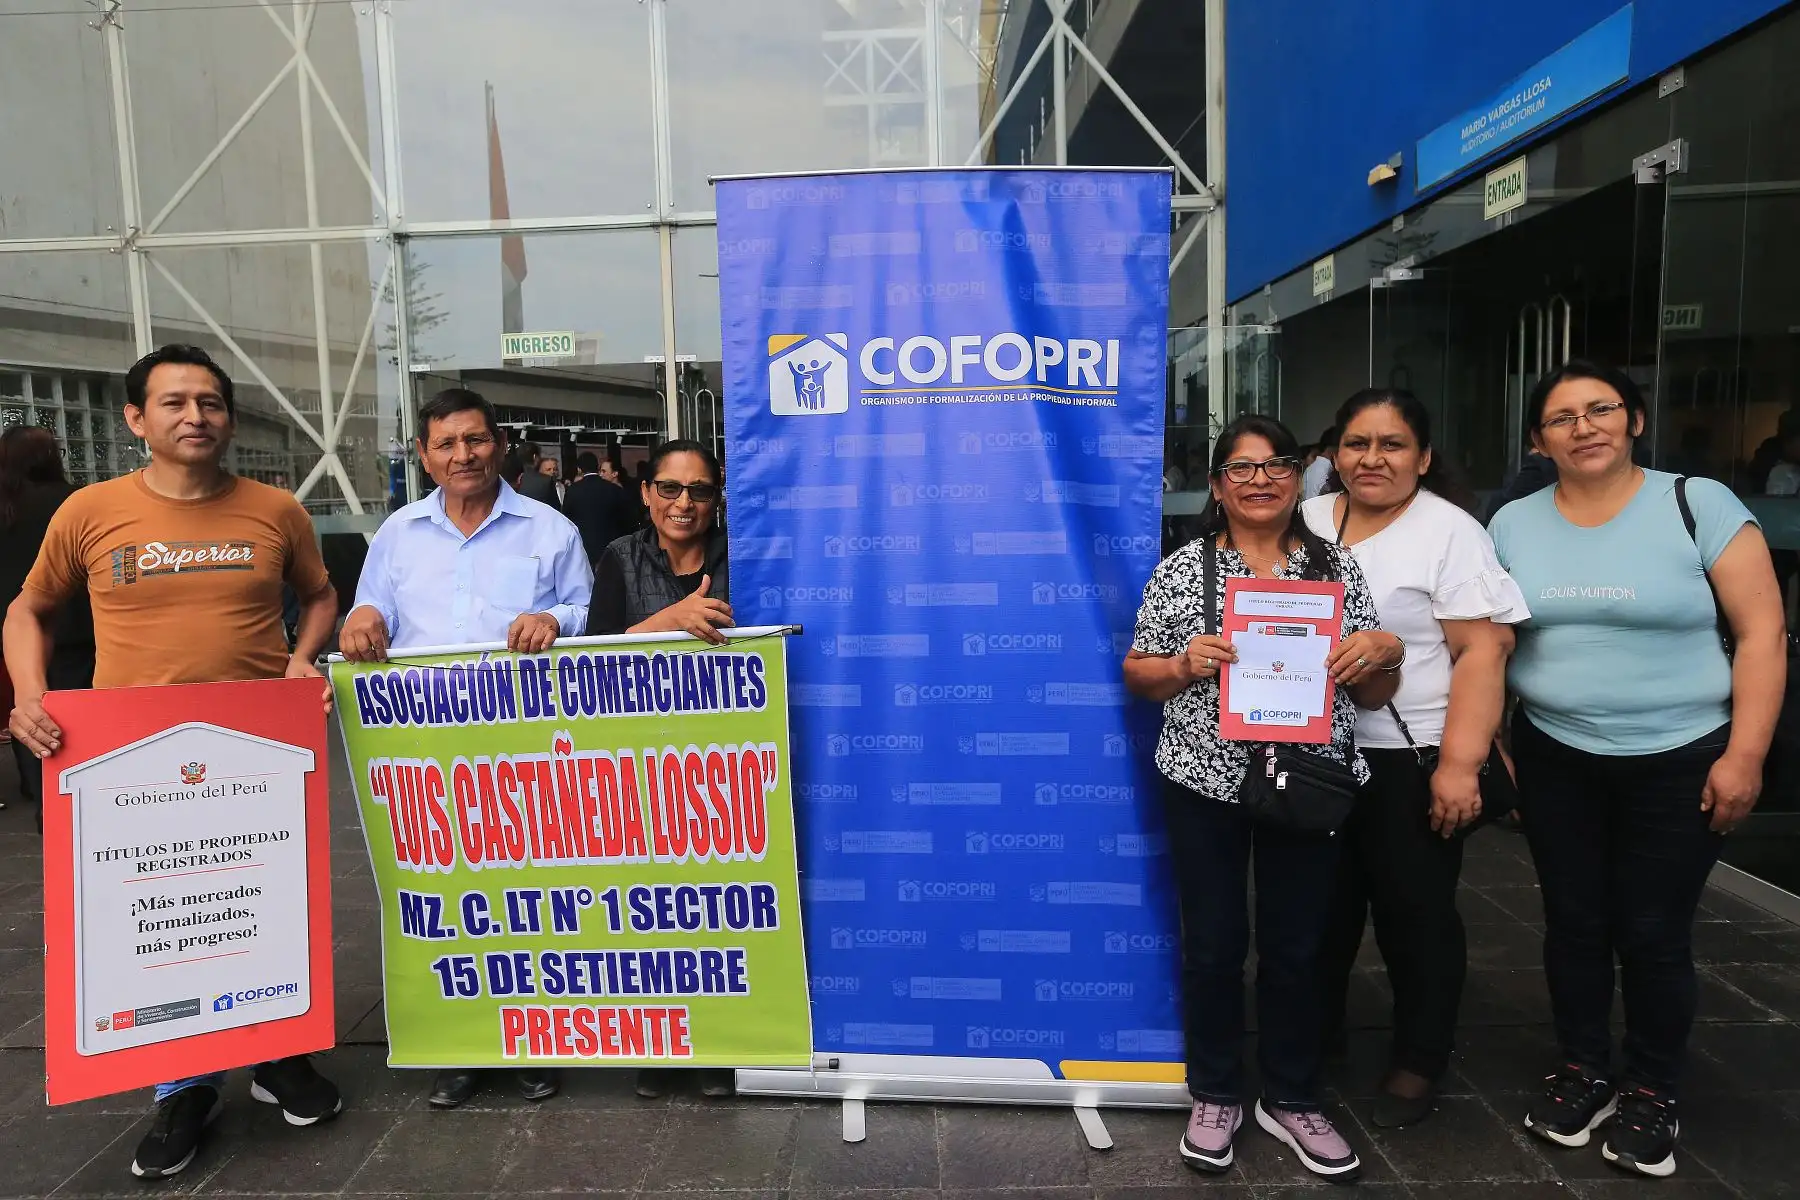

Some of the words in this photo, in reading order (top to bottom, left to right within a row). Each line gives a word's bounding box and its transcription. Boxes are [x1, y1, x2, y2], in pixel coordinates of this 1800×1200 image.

[1461, 115, 1487, 139] MARIO
[1488, 95, 1521, 121] VARGAS
[1523, 75, 1552, 102] LLOSA
[1461, 126, 1495, 154] AUDITORIO
[1500, 97, 1546, 131] AUDITORIUM
[1049, 181, 1124, 198] COFOPRI
[1487, 170, 1522, 206] ENTRADA
[718, 238, 777, 254] OFOPRI
[980, 230, 1050, 248] COFOPRI
[912, 281, 985, 298] COFOPRI
[505, 335, 571, 354] INGRESO
[859, 332, 1121, 388] COFOPRI
[860, 396, 915, 406] ORGANISMO
[916, 396, 928, 405] DE
[929, 392, 1002, 405] FORMALIZACIÓN
[1004, 392, 1016, 402] DE
[1017, 392, 1029, 401] LA
[1030, 392, 1072, 405] PROPIEDAD
[1073, 397, 1118, 408] INFORMAL
[725, 438, 785, 454] OFOPRI
[985, 432, 1058, 447] COFOPRI
[915, 484, 989, 499] COFOPRI
[848, 535, 920, 551] COFOPRI
[1111, 535, 1160, 551] COFO
[137, 541, 254, 573] Superior
[784, 586, 854, 601] COFOPRI
[1057, 584, 1118, 599] COFOPRI
[1540, 585, 1577, 599] LOUIS
[1580, 586, 1636, 600] VUITTON
[988, 633, 1064, 649] COFOPRI
[1242, 671, 1278, 681] Gobierno
[1280, 672, 1292, 681] del
[1294, 674, 1312, 683] Perú
[354, 653, 517, 726] ASOCIACIÓN
[519, 656, 556, 719] DE
[558, 652, 766, 719] COMERCIANTES
[919, 685, 993, 699] COFOPRI
[1263, 709, 1302, 720] COFOPRI
[852, 735, 924, 749] COFOPRI
[114, 789, 196, 807] Gobierno
[201, 784, 226, 799] del
[232, 780, 268, 796] Perú
[800, 784, 858, 798] OFOPRI
[1060, 784, 1135, 800] COFOPRI
[453, 736, 646, 865] CASTAÑEDA
[93, 843, 168, 863] TÍTULOS
[172, 840, 195, 853] DE
[199, 829, 290, 850] PROPIEDAD
[991, 833, 1064, 849] COFOPRI
[136, 849, 253, 874] REGISTRADOS
[923, 881, 996, 896] COFOPRI
[131, 895, 175, 917] ¡Más
[181, 885, 263, 906] mercados
[399, 892, 455, 939] MZ.
[462, 892, 501, 936] C.
[506, 890, 543, 934] LT
[602, 888, 624, 932] 1
[631, 883, 778, 932] SECTOR
[137, 907, 256, 934] formalizados,
[135, 938, 172, 956] más
[178, 924, 258, 952] progreso!
[855, 929, 927, 944] COFOPRI
[1130, 934, 1176, 949] COFO
[432, 954, 479, 998] 15
[485, 952, 533, 996] DE
[542, 949, 748, 995] SETIEMBRE
[235, 982, 298, 1002] COFOPRI
[1060, 982, 1134, 997] COFOPRI
[136, 1006, 162, 1015] Ministerio
[167, 1005, 198, 1014] Construcción
[115, 1016, 132, 1025] PERÚ
[501, 1006, 691, 1058] PRESENTE
[991, 1029, 1065, 1045] COFOPRI
